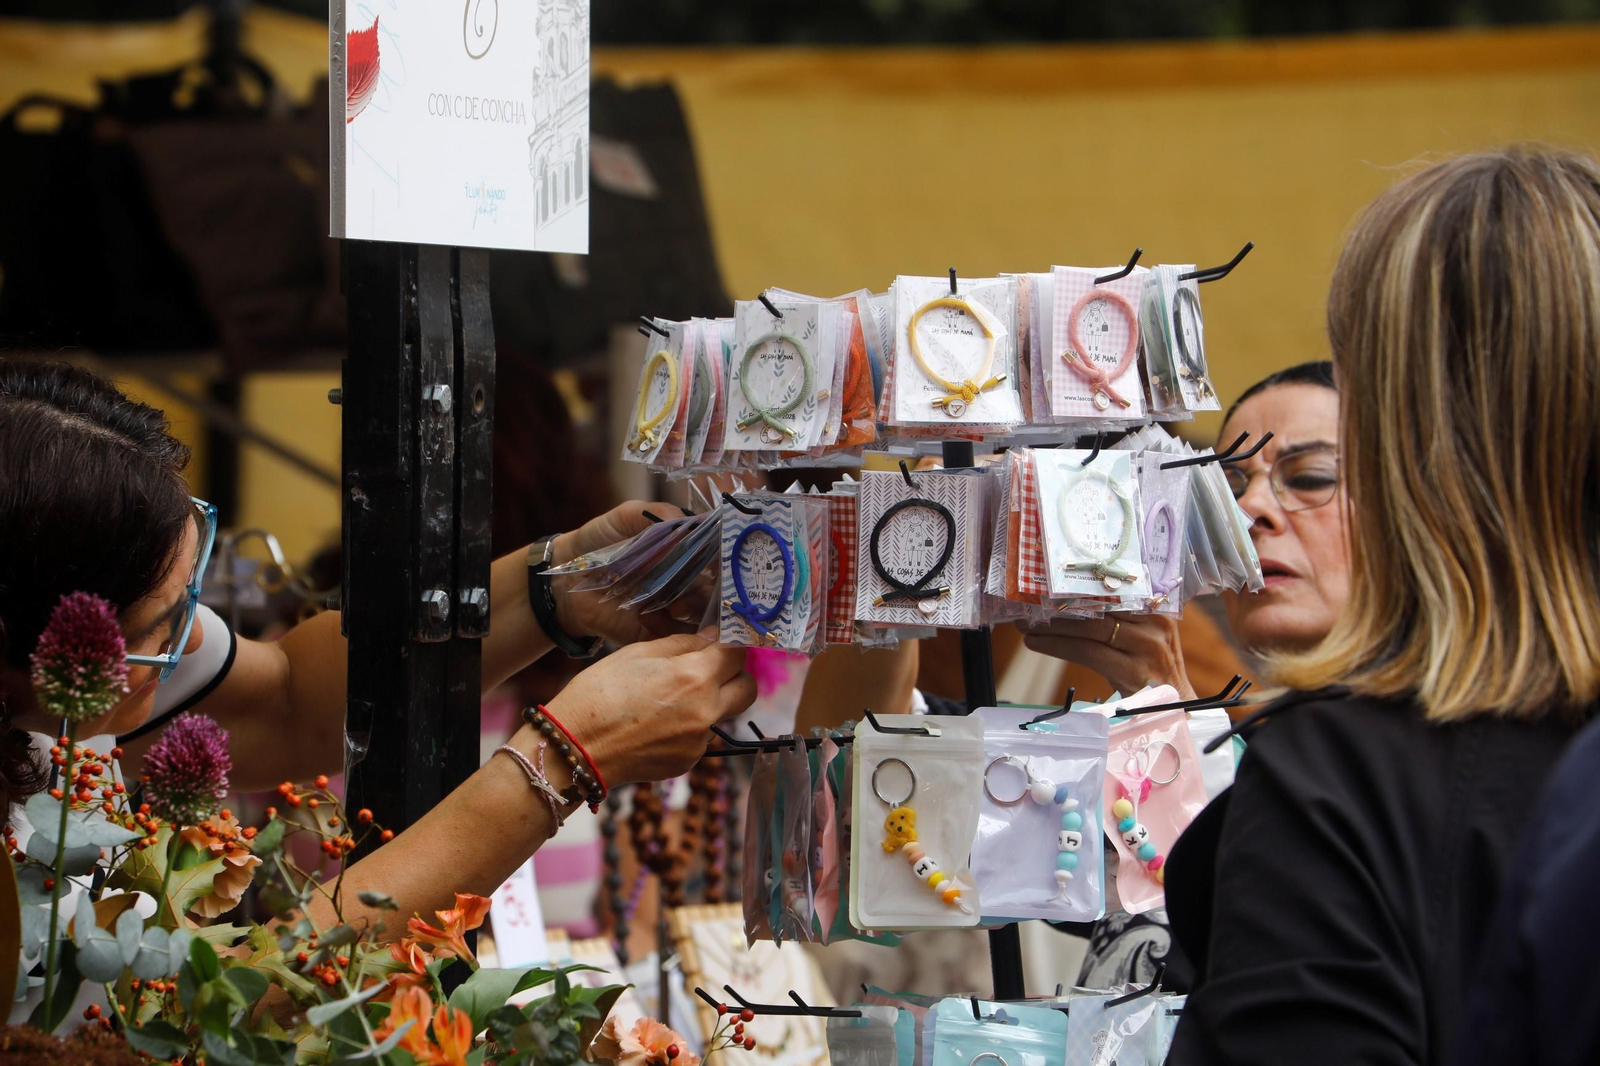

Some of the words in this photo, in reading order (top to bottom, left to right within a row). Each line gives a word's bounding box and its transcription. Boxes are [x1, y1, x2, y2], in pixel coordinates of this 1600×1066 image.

[428, 93, 452, 117] CON
[454, 96, 463, 118] C
[465, 96, 479, 120] DE
[481, 98, 526, 125] CONCHA
[961, 328, 974, 336] MAMÁ
[1093, 353, 1101, 361] DE
[1102, 352, 1118, 364] MAMÁ
[897, 567, 914, 578] COSAS
[915, 568, 924, 577] DE
[748, 591, 760, 601] COSAS
[761, 591, 768, 600] DE
[1138, 827, 1147, 839] K
[1067, 836, 1078, 847] J
[1126, 836, 1138, 846] K
